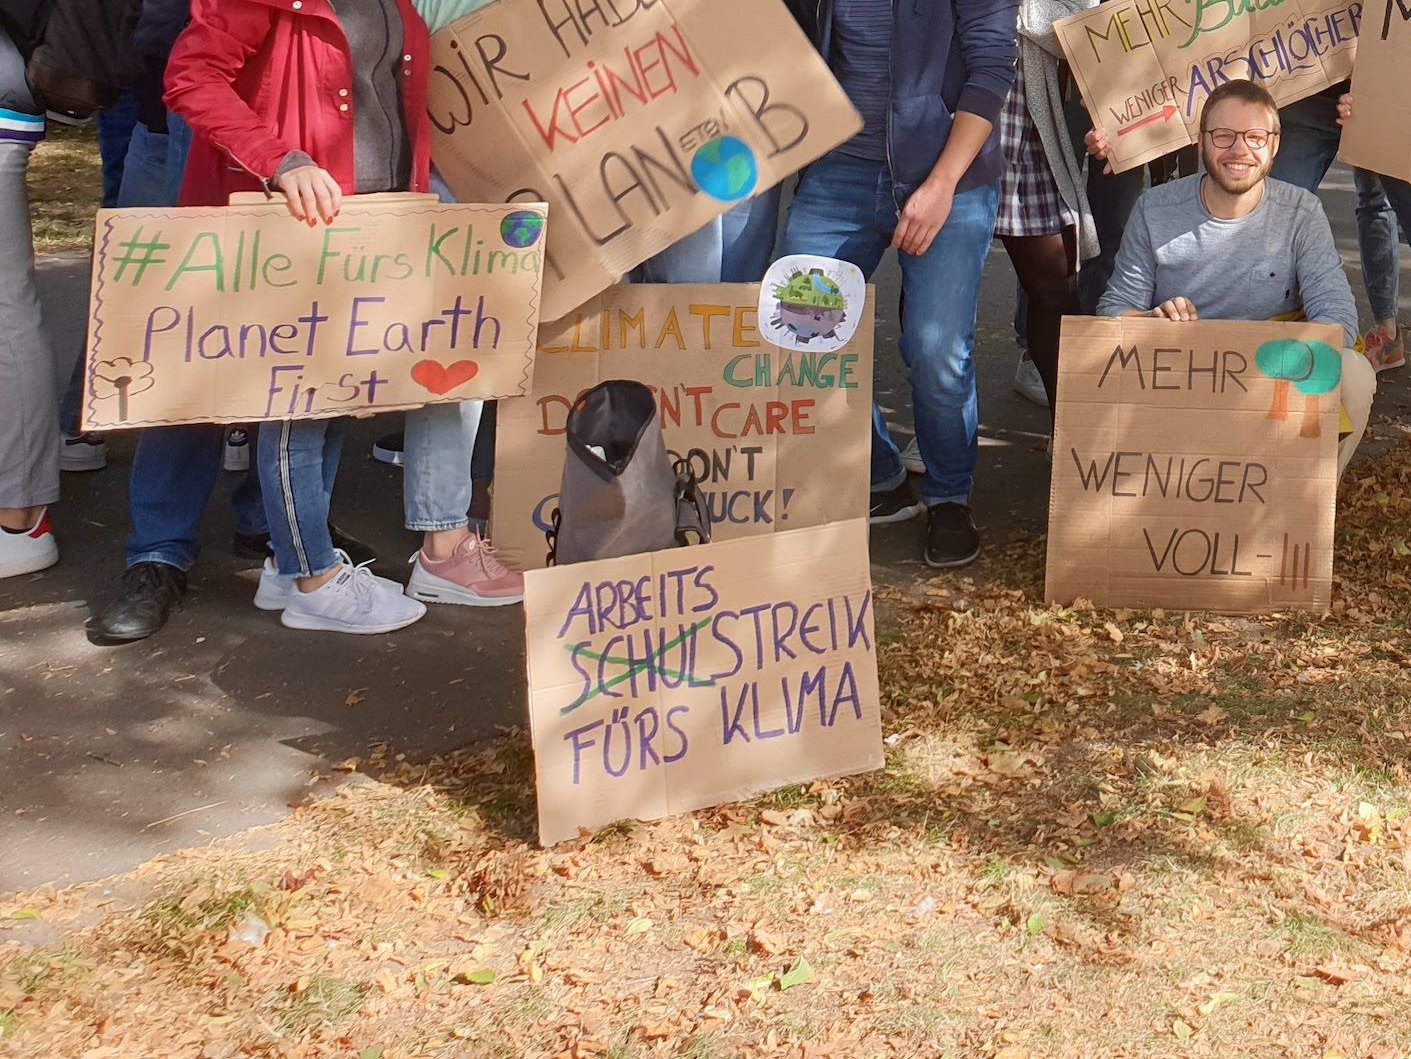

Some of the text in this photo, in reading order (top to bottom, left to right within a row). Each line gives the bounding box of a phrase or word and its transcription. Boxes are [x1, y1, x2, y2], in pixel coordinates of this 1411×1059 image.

[522, 24, 701, 153] KEINEN
[1109, 76, 1187, 126] WENIGER
[505, 76, 810, 282] LAN B
[111, 223, 541, 293] #Alle Fürs Klima
[143, 294, 502, 363] Planet Earth
[264, 364, 389, 418] First
[723, 352, 860, 389] CHANGE
[1098, 344, 1248, 394] MEHR
[710, 398, 817, 440] CARE
[1070, 447, 1268, 504] WENIGER
[556, 564, 719, 639] ARBEITS
[563, 661, 863, 785] FÜRS KLIMA
